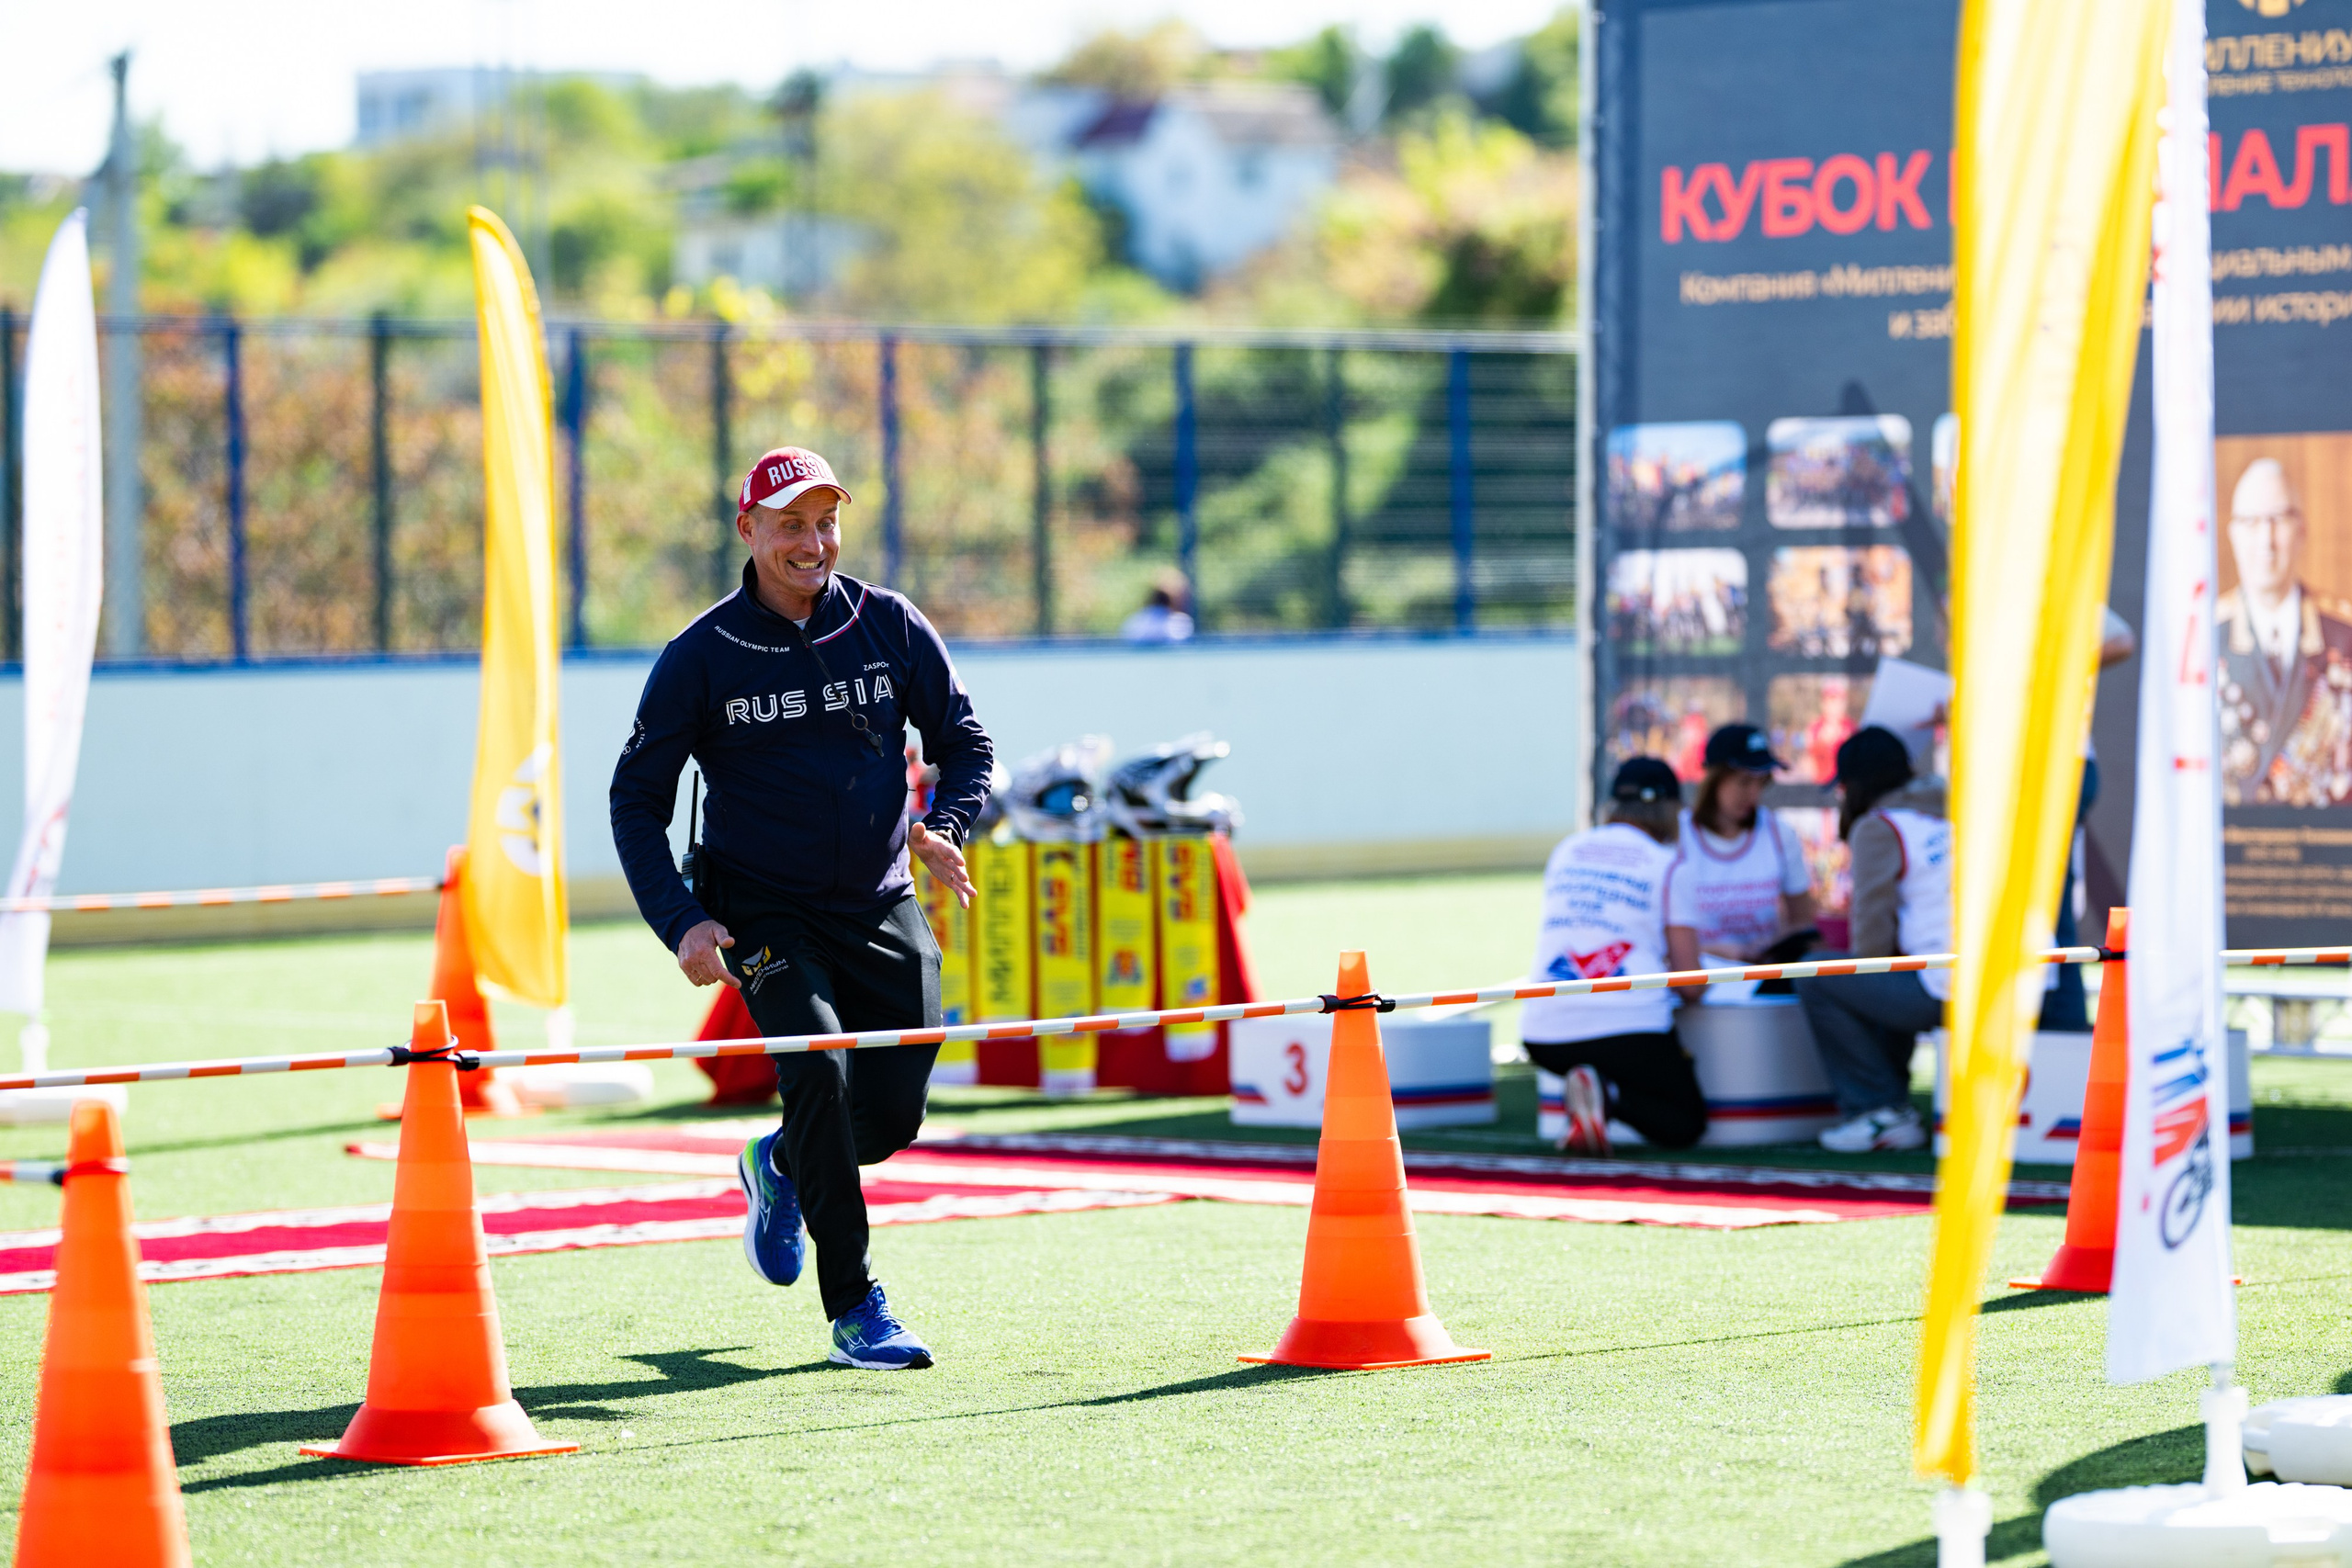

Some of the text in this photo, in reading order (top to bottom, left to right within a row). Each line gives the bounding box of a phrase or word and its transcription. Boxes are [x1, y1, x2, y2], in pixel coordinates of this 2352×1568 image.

[1660, 149, 1933, 243] КУБОК
[1679, 269, 1816, 306] Компания
[714, 625, 741, 644] RUSSIAN
[740, 639, 769, 653] OLYMPIC
[1283, 1041, 1309, 1096] 3
